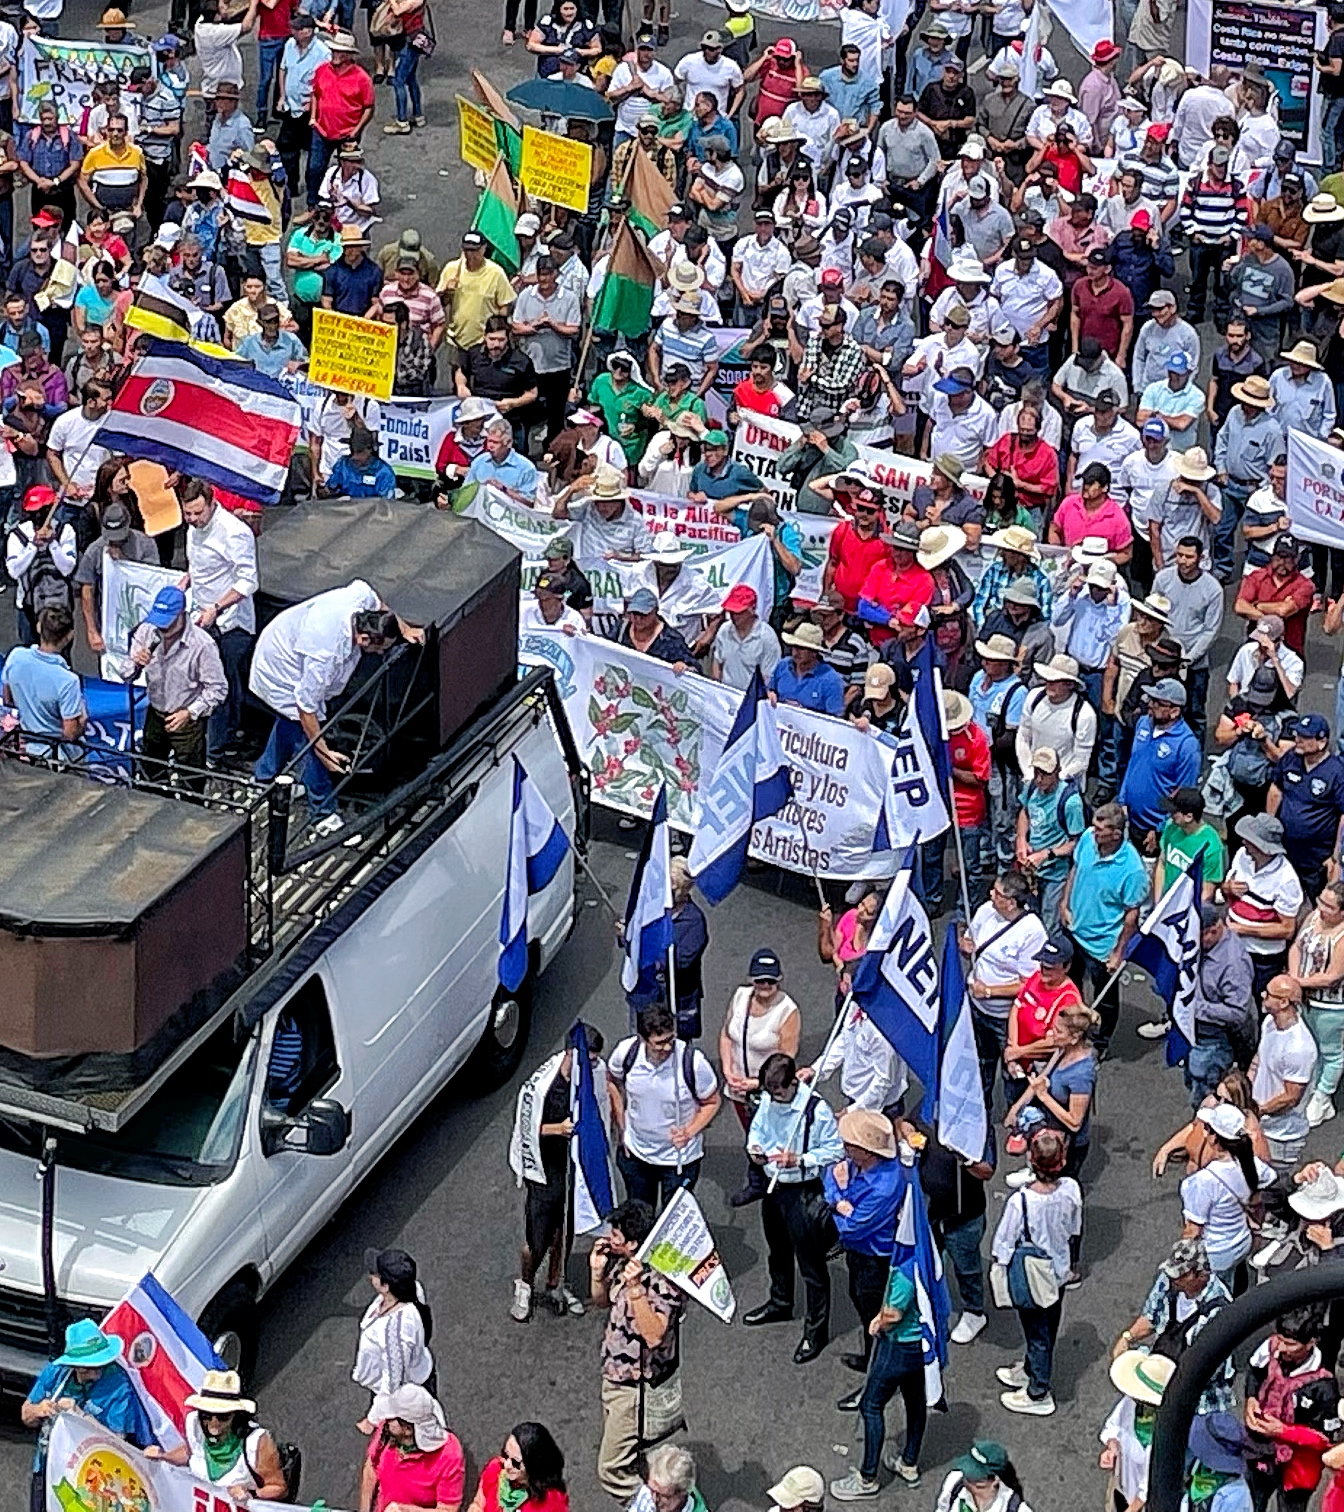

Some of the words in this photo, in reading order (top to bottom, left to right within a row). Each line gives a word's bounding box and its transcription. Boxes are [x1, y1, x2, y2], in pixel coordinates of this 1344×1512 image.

[745, 423, 792, 453] UPAN
[684, 504, 732, 526] Alian
[778, 724, 850, 772] ricultura
[807, 774, 821, 803] y
[822, 774, 849, 809] los
[765, 832, 831, 871] Artistas
